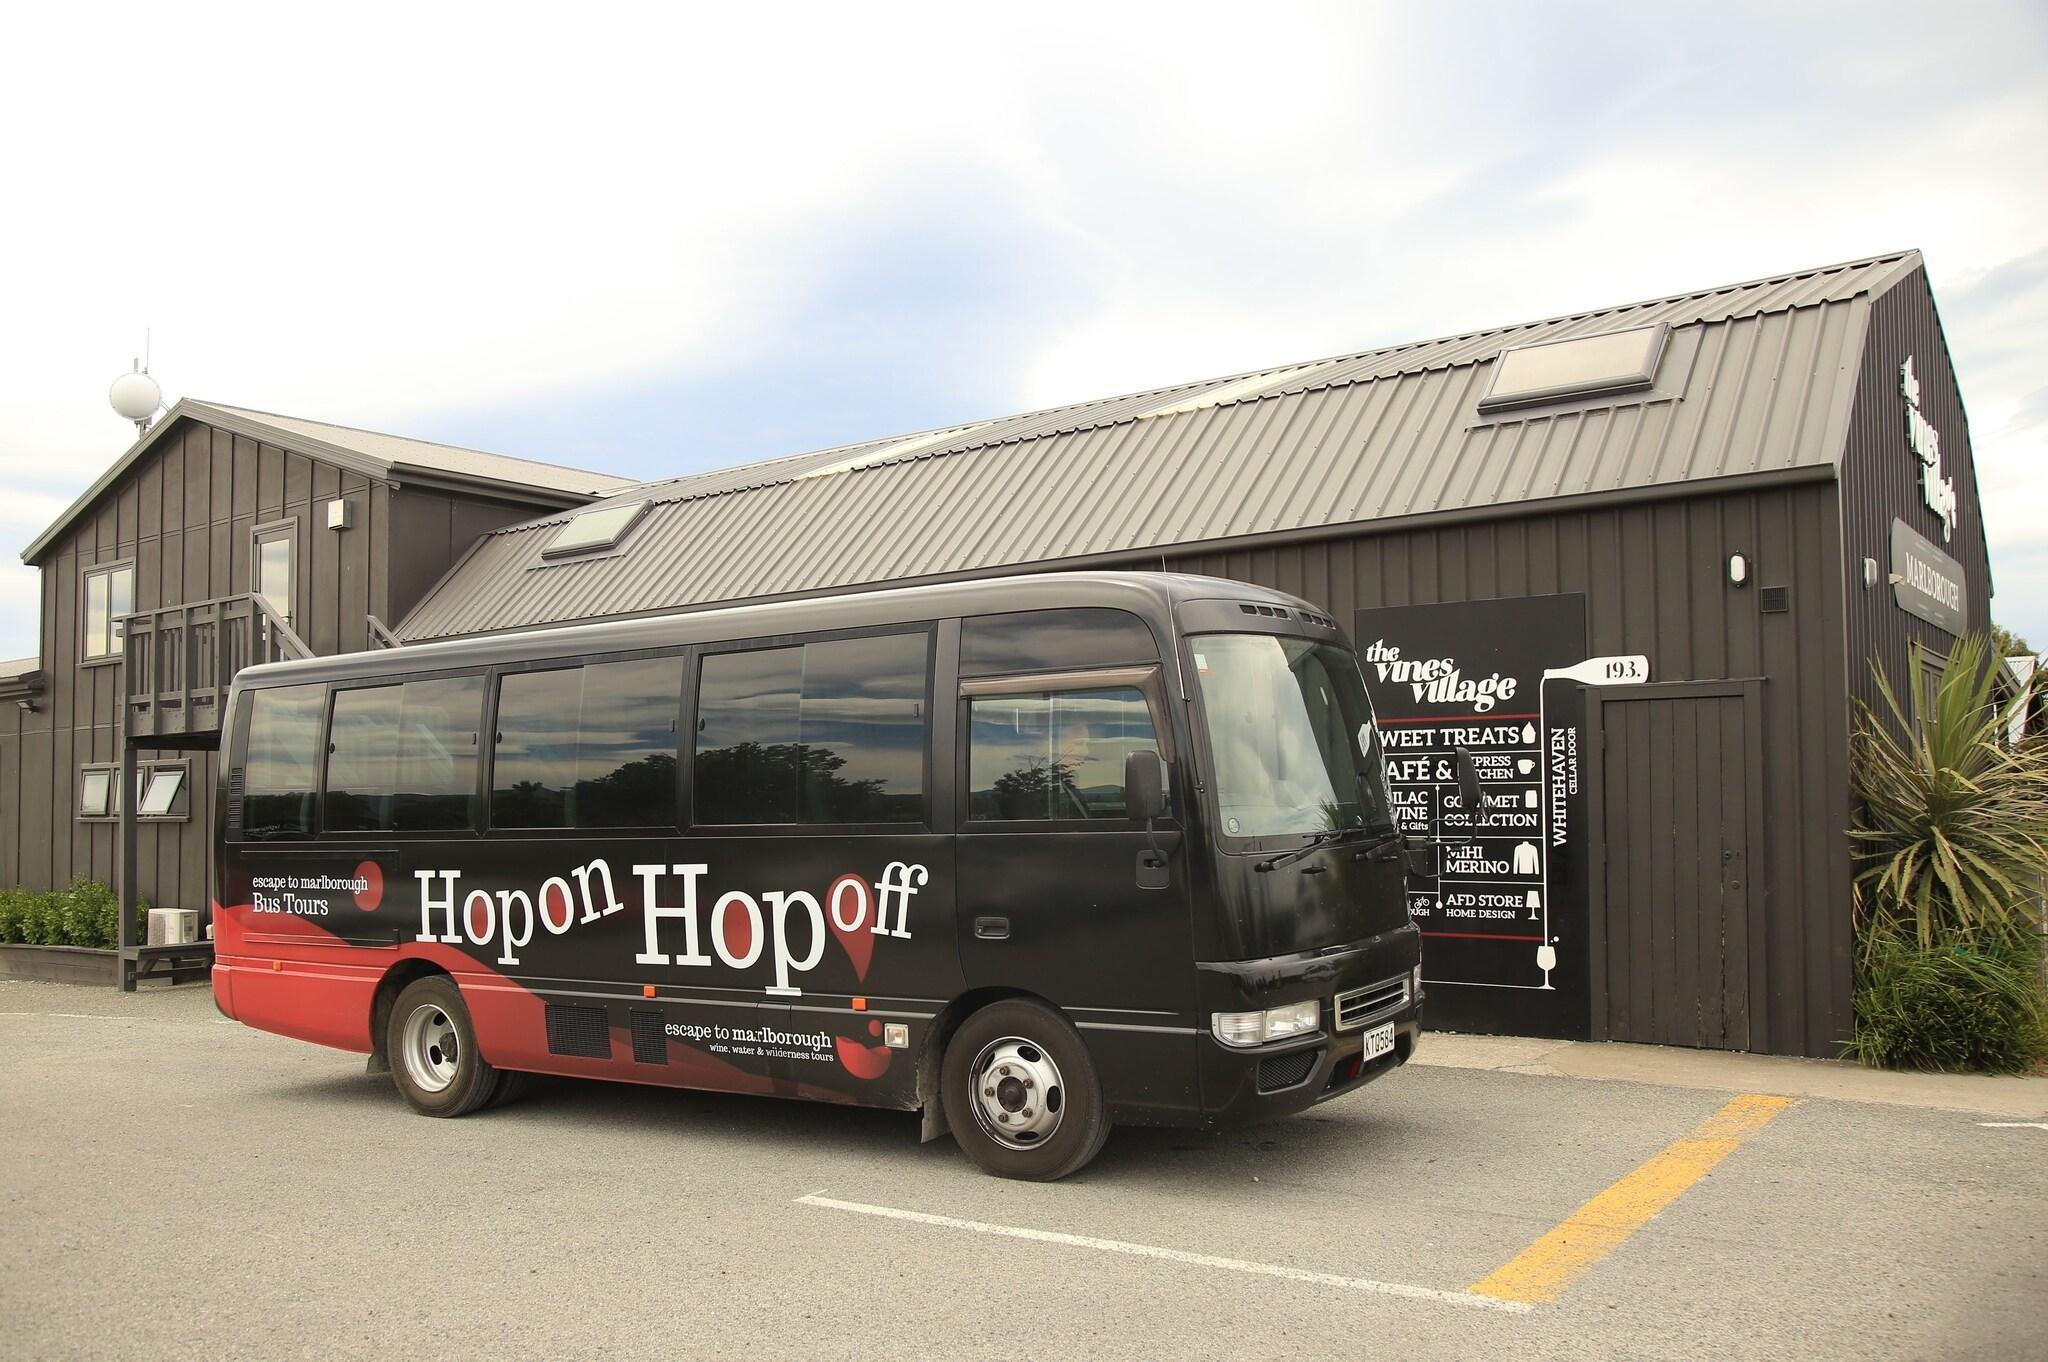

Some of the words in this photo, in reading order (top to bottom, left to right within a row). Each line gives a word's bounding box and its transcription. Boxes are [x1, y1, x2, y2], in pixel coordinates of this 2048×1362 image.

[1905, 551, 1959, 612] MARLBOROUGH
[1366, 638, 1400, 662] the
[1379, 729, 1436, 747] WEET
[1440, 726, 1520, 746] TREATS
[1567, 726, 1577, 757] DOOR
[1387, 756, 1430, 781] AFÉ
[1435, 759, 1453, 781] &
[1471, 756, 1511, 767] PRESS
[1475, 768, 1514, 779] CHEN
[1568, 757, 1577, 795] CELLAR
[1551, 727, 1567, 847] WHITEHAVEN
[1392, 791, 1428, 805] ILAC
[1443, 795, 1520, 808] GOMET
[1400, 822, 1408, 830] &
[1409, 821, 1429, 831] Gifts
[1445, 860, 1510, 874] MERINO
[252, 876, 286, 891] escape
[288, 875, 299, 888] to
[300, 875, 369, 895] marlborough
[252, 892, 281, 913] Bus
[283, 893, 329, 916] Tours
[1446, 893, 1476, 906] AFD
[1479, 894, 1523, 908] STORE
[1446, 908, 1477, 918] HOME
[1478, 909, 1516, 919] DESIGN
[415, 869, 534, 965] Hop
[538, 858, 625, 935] on
[633, 864, 827, 996] Hop
[830, 861, 929, 940] off
[665, 1023, 711, 1041] escape
[714, 1024, 729, 1040] to
[732, 1027, 833, 1052] marlborough
[709, 1042, 731, 1054] wine,
[732, 1045, 755, 1056] water
[756, 1047, 764, 1056] &
[766, 1047, 810, 1060] wilderness
[811, 1051, 834, 1062] tours
